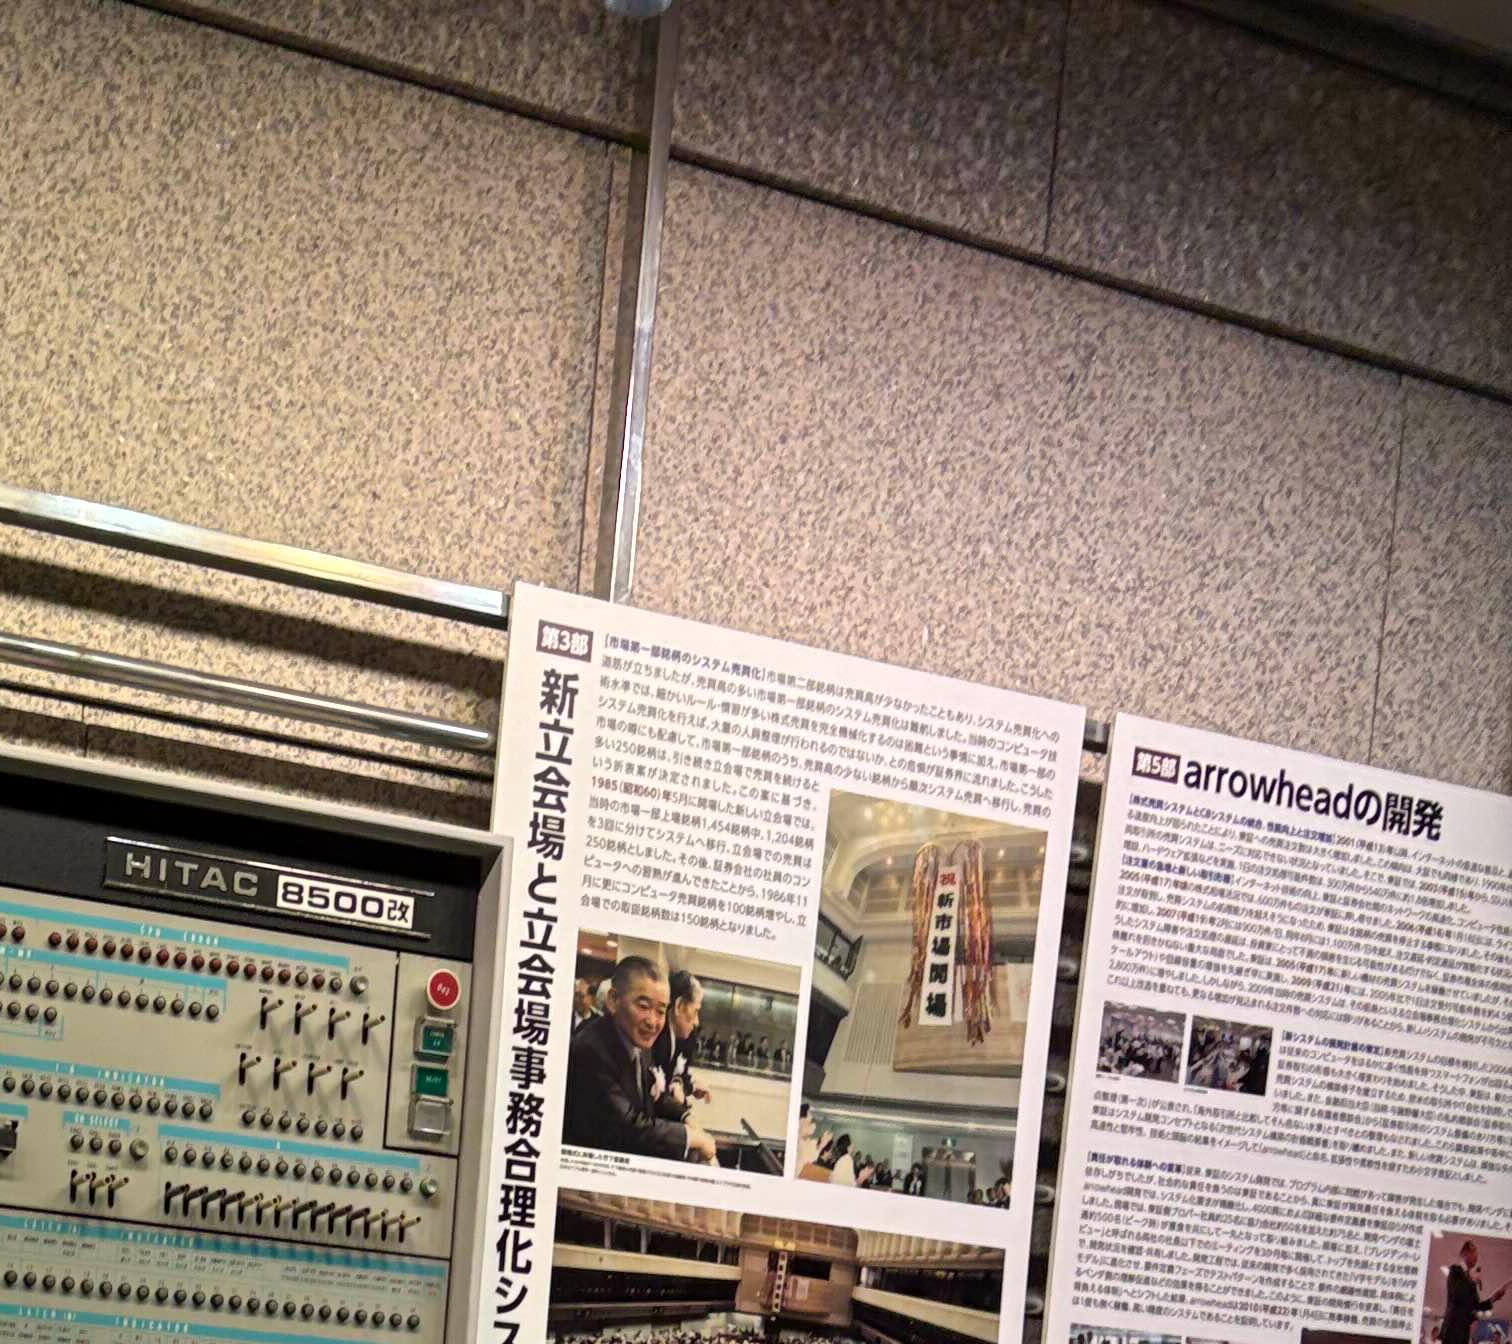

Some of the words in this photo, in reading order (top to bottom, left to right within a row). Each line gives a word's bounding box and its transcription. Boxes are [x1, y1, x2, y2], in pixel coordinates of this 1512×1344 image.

[540, 625, 590, 660] 第3部
[1184, 759, 1445, 842] arrowheadの開発
[124, 851, 260, 897] HITAC
[281, 881, 413, 924] 8500改
